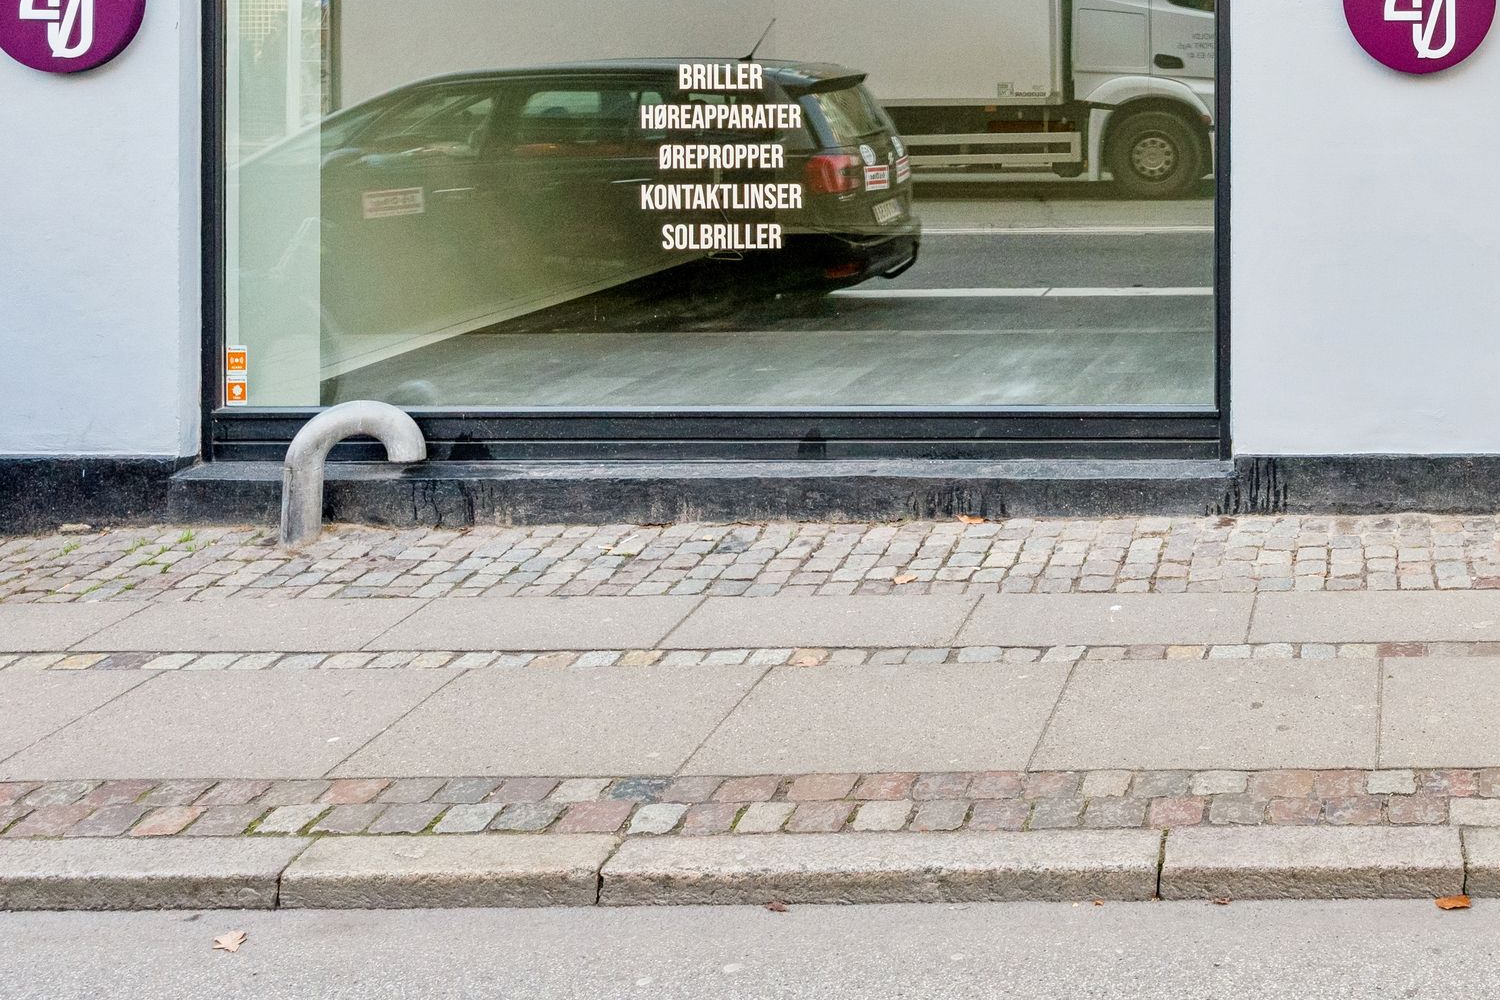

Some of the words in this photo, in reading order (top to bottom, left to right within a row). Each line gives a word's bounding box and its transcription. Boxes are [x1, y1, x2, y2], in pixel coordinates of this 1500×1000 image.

[679, 64, 763, 90] BRILLER
[641, 104, 801, 129] HØREAPPARATER
[659, 144, 784, 169] ØREPROPPER
[641, 184, 802, 209] KONTAKTLINSER
[662, 223, 782, 250] SOLBRILLER
